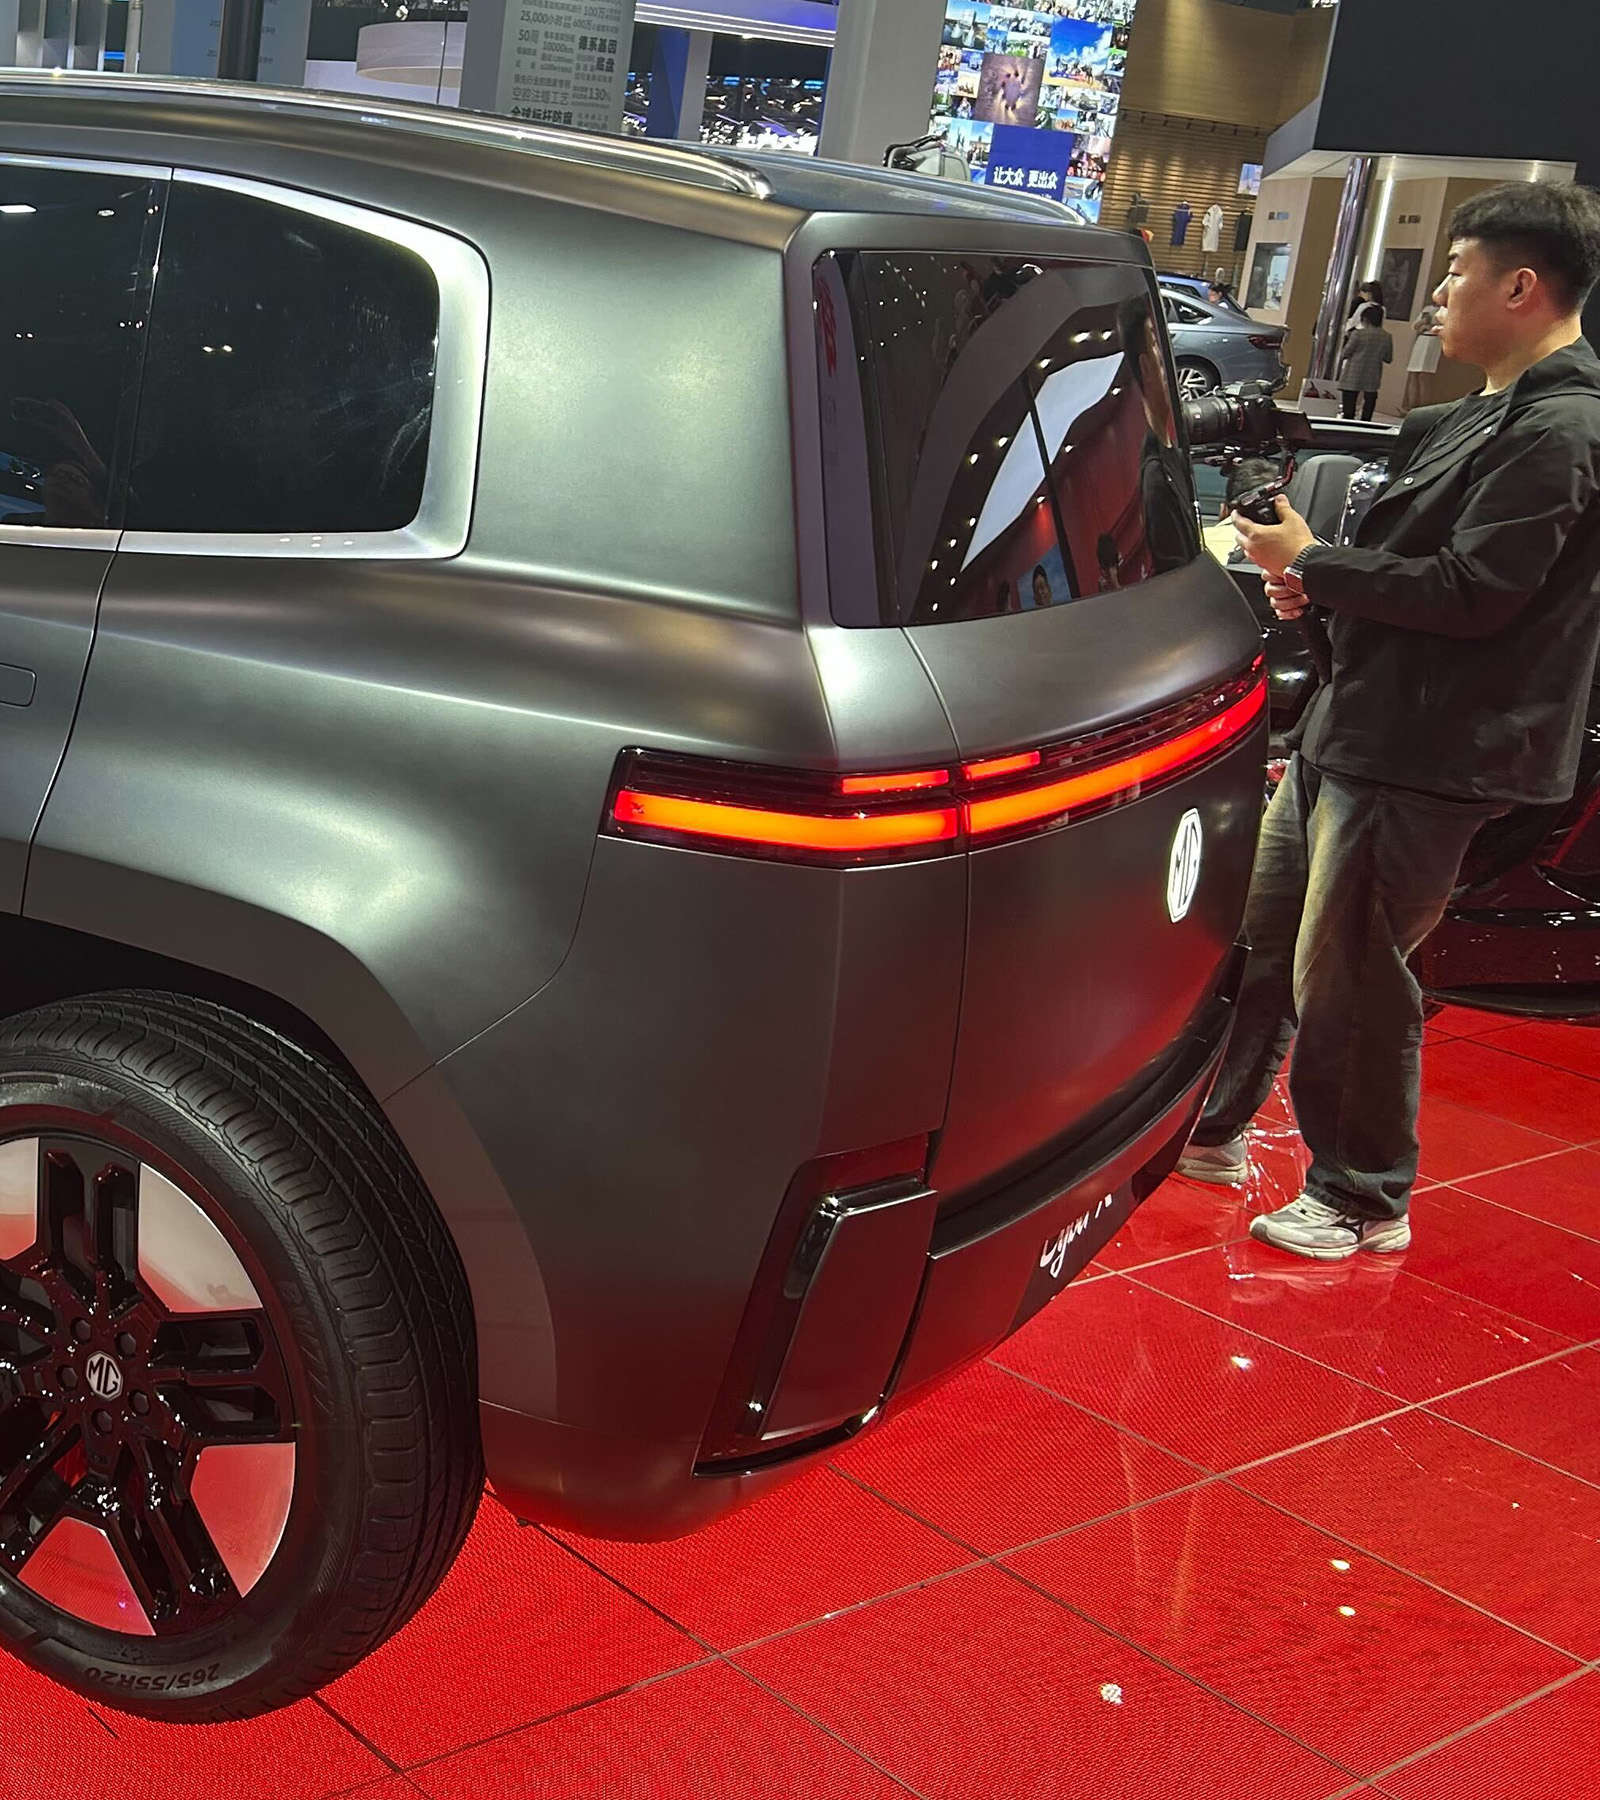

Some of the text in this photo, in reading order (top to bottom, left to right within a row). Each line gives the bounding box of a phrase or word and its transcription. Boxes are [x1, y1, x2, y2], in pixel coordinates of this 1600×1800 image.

[993, 166, 1059, 190] 让大众 更出众
[1169, 817, 1201, 913] MG
[87, 1355, 120, 1396] MG
[82, 1662, 221, 1691] 265/55R20
